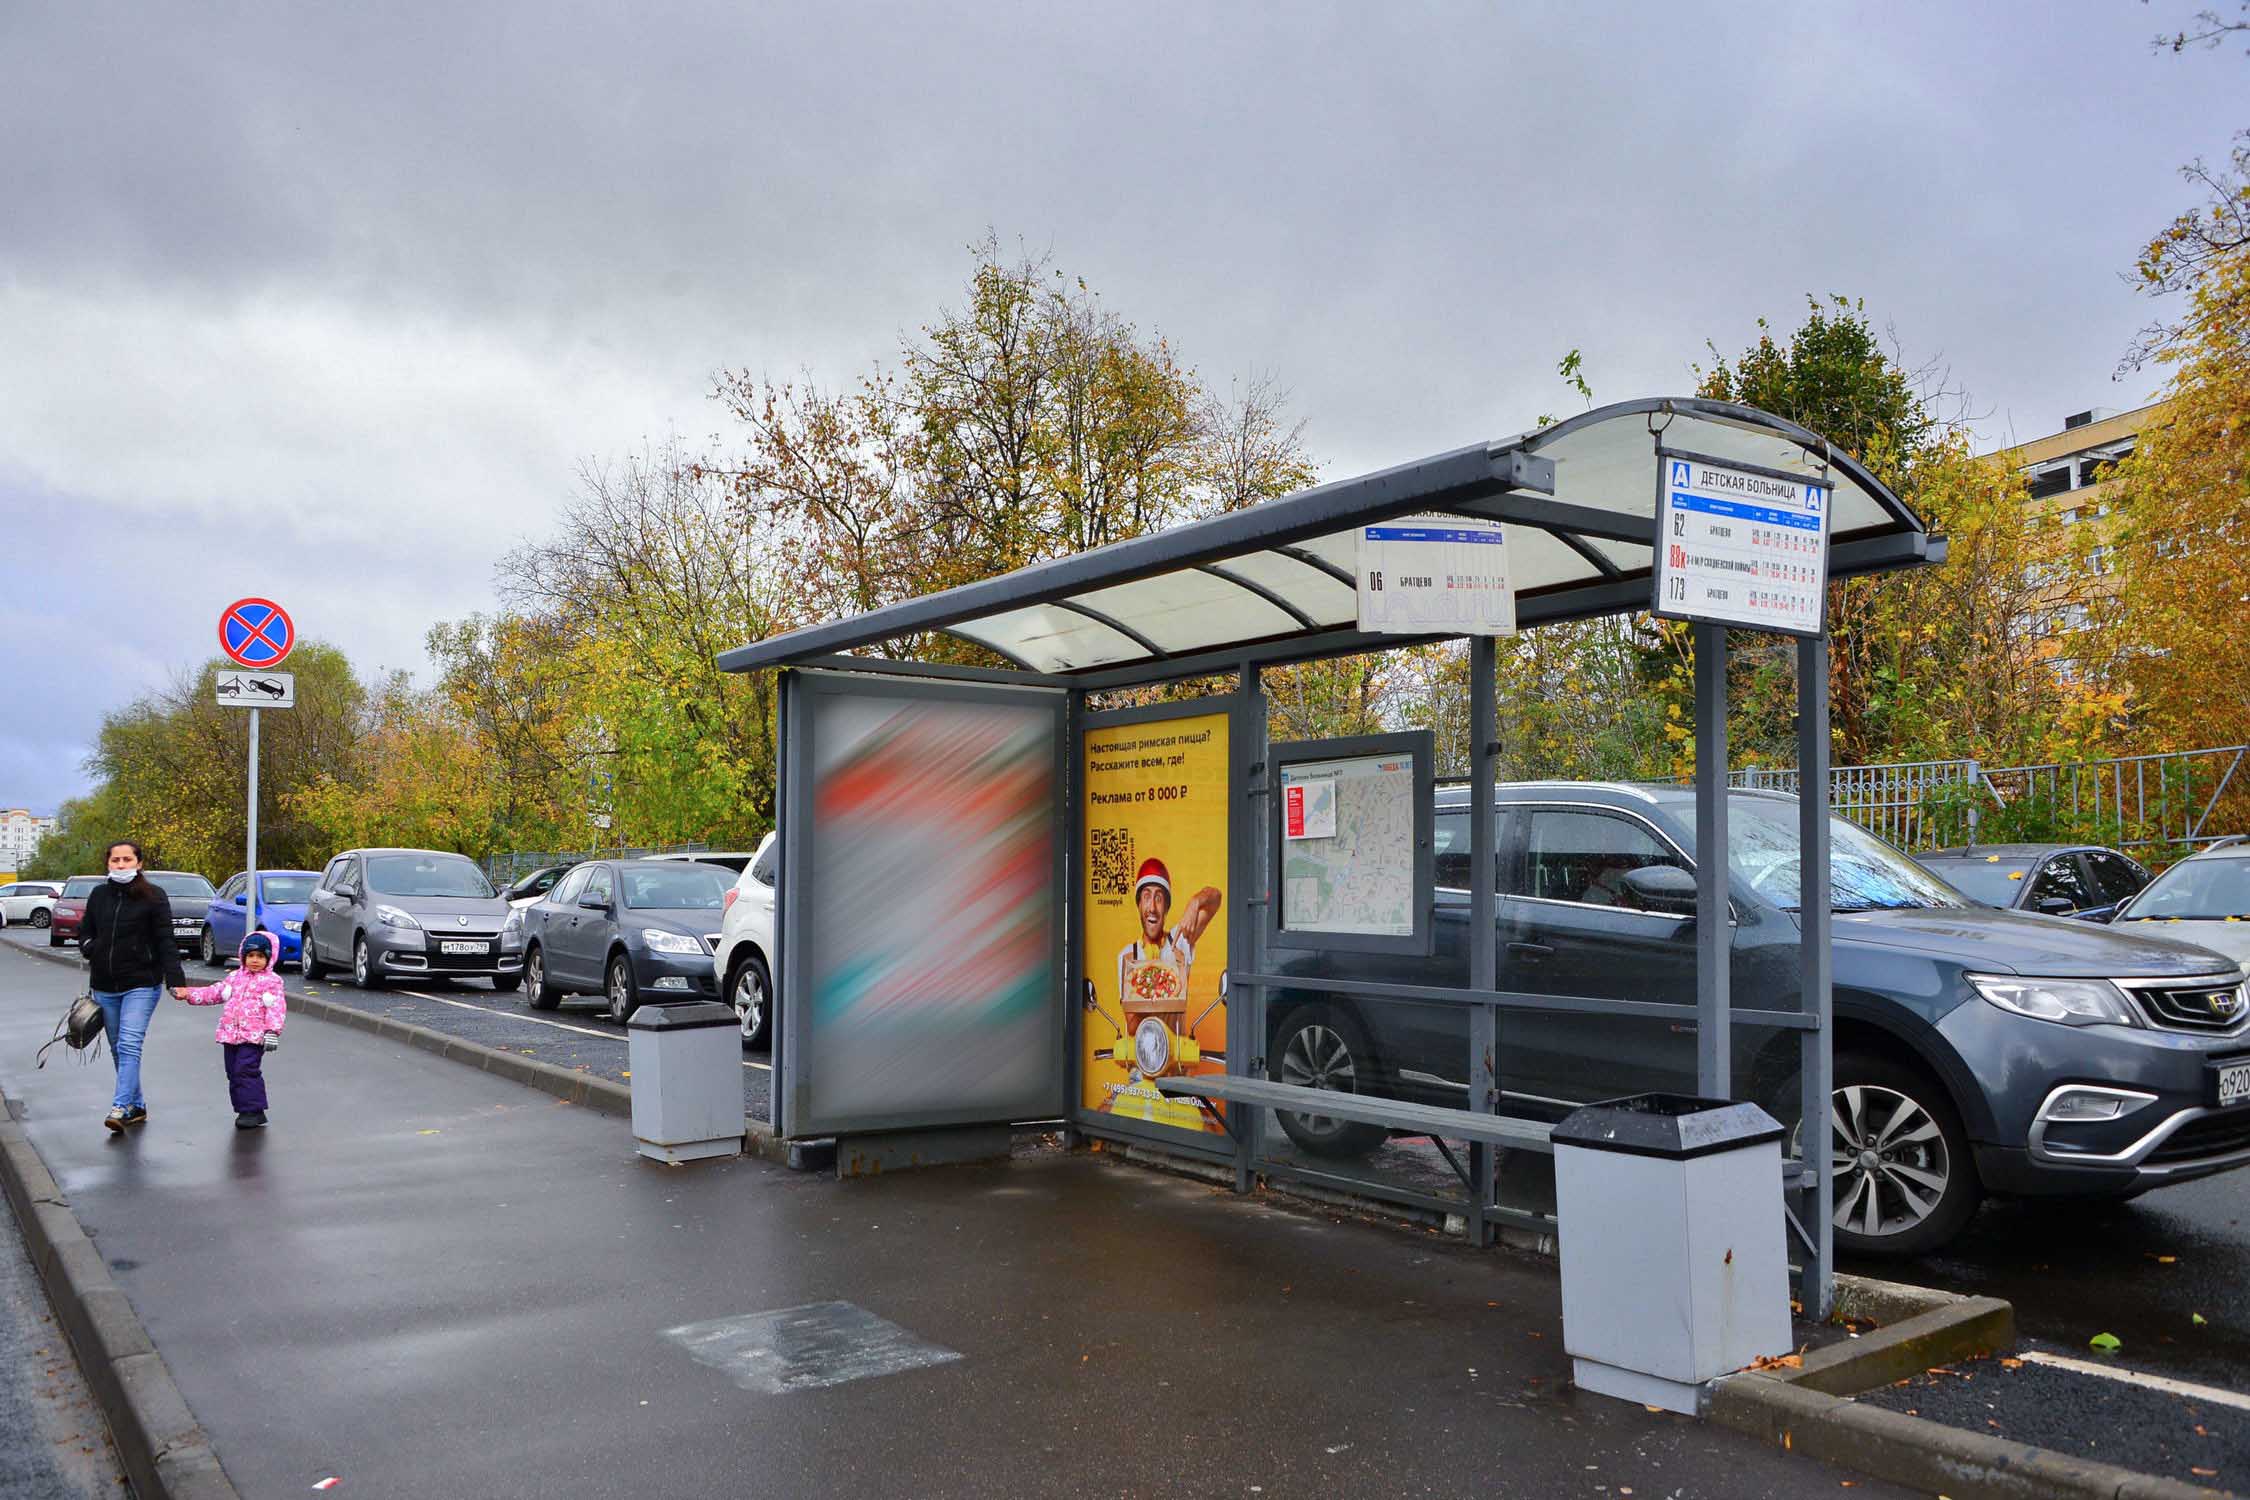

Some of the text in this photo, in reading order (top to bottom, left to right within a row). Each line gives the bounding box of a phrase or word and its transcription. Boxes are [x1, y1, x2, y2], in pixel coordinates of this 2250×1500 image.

[1701, 471, 1744, 490] ДЕТСКАЯ
[1747, 479, 1796, 500] БОЛЬНИЦА
[1674, 513, 1685, 537] 62
[1370, 571, 1383, 591] 06
[1399, 576, 1432, 588] БРАТЦЕВО
[1670, 576, 1685, 601] 173
[1090, 729, 1211, 754] Настоящая римская пицца?
[1090, 752, 1185, 773] Расскажите всем, где!
[1091, 791, 1132, 805] Реклама
[1135, 791, 1146, 802] от
[1148, 787, 1155, 801] 8
[1157, 786, 1178, 800] 000
